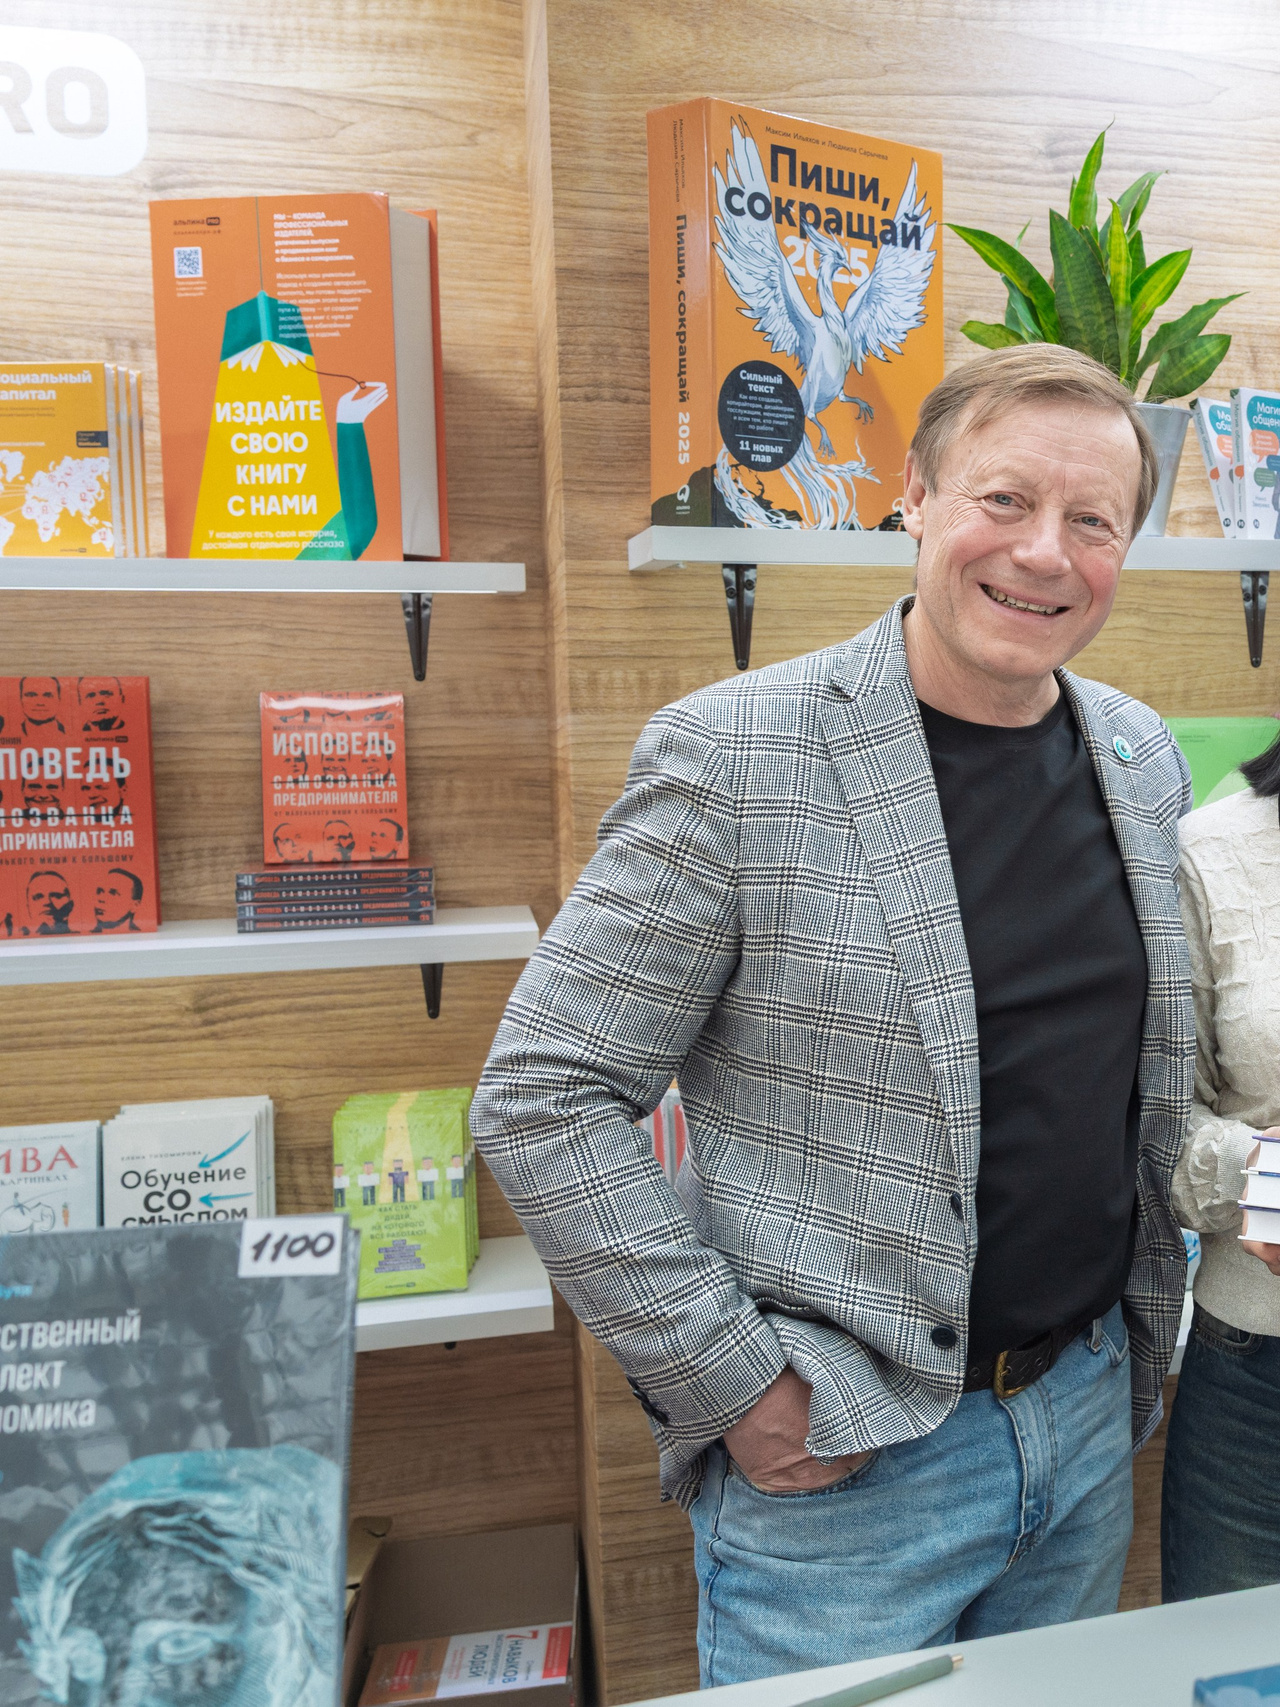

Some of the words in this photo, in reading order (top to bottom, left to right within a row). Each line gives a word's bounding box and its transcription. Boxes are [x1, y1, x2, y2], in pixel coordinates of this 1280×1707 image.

[765, 126, 792, 138] Максим
[793, 132, 820, 145] Ильяхов
[827, 140, 858, 154] Людмила
[859, 148, 889, 161] Сарычева
[770, 144, 890, 212] Пиши,
[724, 186, 922, 251] сокращай
[676, 214, 687, 285] Пиши,
[676, 289, 690, 403] сокращай
[739, 369, 783, 385] Сильный
[747, 382, 775, 394] текст
[215, 395, 322, 425] ИЗДАЙТЕ
[230, 431, 309, 454] СВОЮ
[678, 411, 690, 465] 2025
[739, 440, 751, 451] 11
[752, 443, 784, 453] новых
[751, 454, 772, 463] глав
[236, 463, 307, 485] КНИГУ
[227, 495, 246, 517] С
[250, 494, 318, 516] НАМИ
[208, 530, 215, 538] У
[216, 530, 252, 539] каждого
[275, 530, 297, 538] своя
[302, 540, 345, 550] рассказа
[273, 732, 397, 757] ИСПОВЕДЬ
[0, 746, 131, 783] ПОВЕДЬ
[273, 773, 398, 791] САМОЗВАНЦА
[273, 791, 398, 807] ПРЕДПРИНИМАТЕЛЯ
[0, 830, 134, 852] ПРИНИМАТЕЛЯ
[120, 1166, 247, 1191] Обучение
[251, 1231, 335, 1263] 1100
[505, 1630, 539, 1639] 7
[468, 1644, 490, 1678] ЛЮДЕЙ
[502, 1639, 524, 1684] НАВЫКОВ
